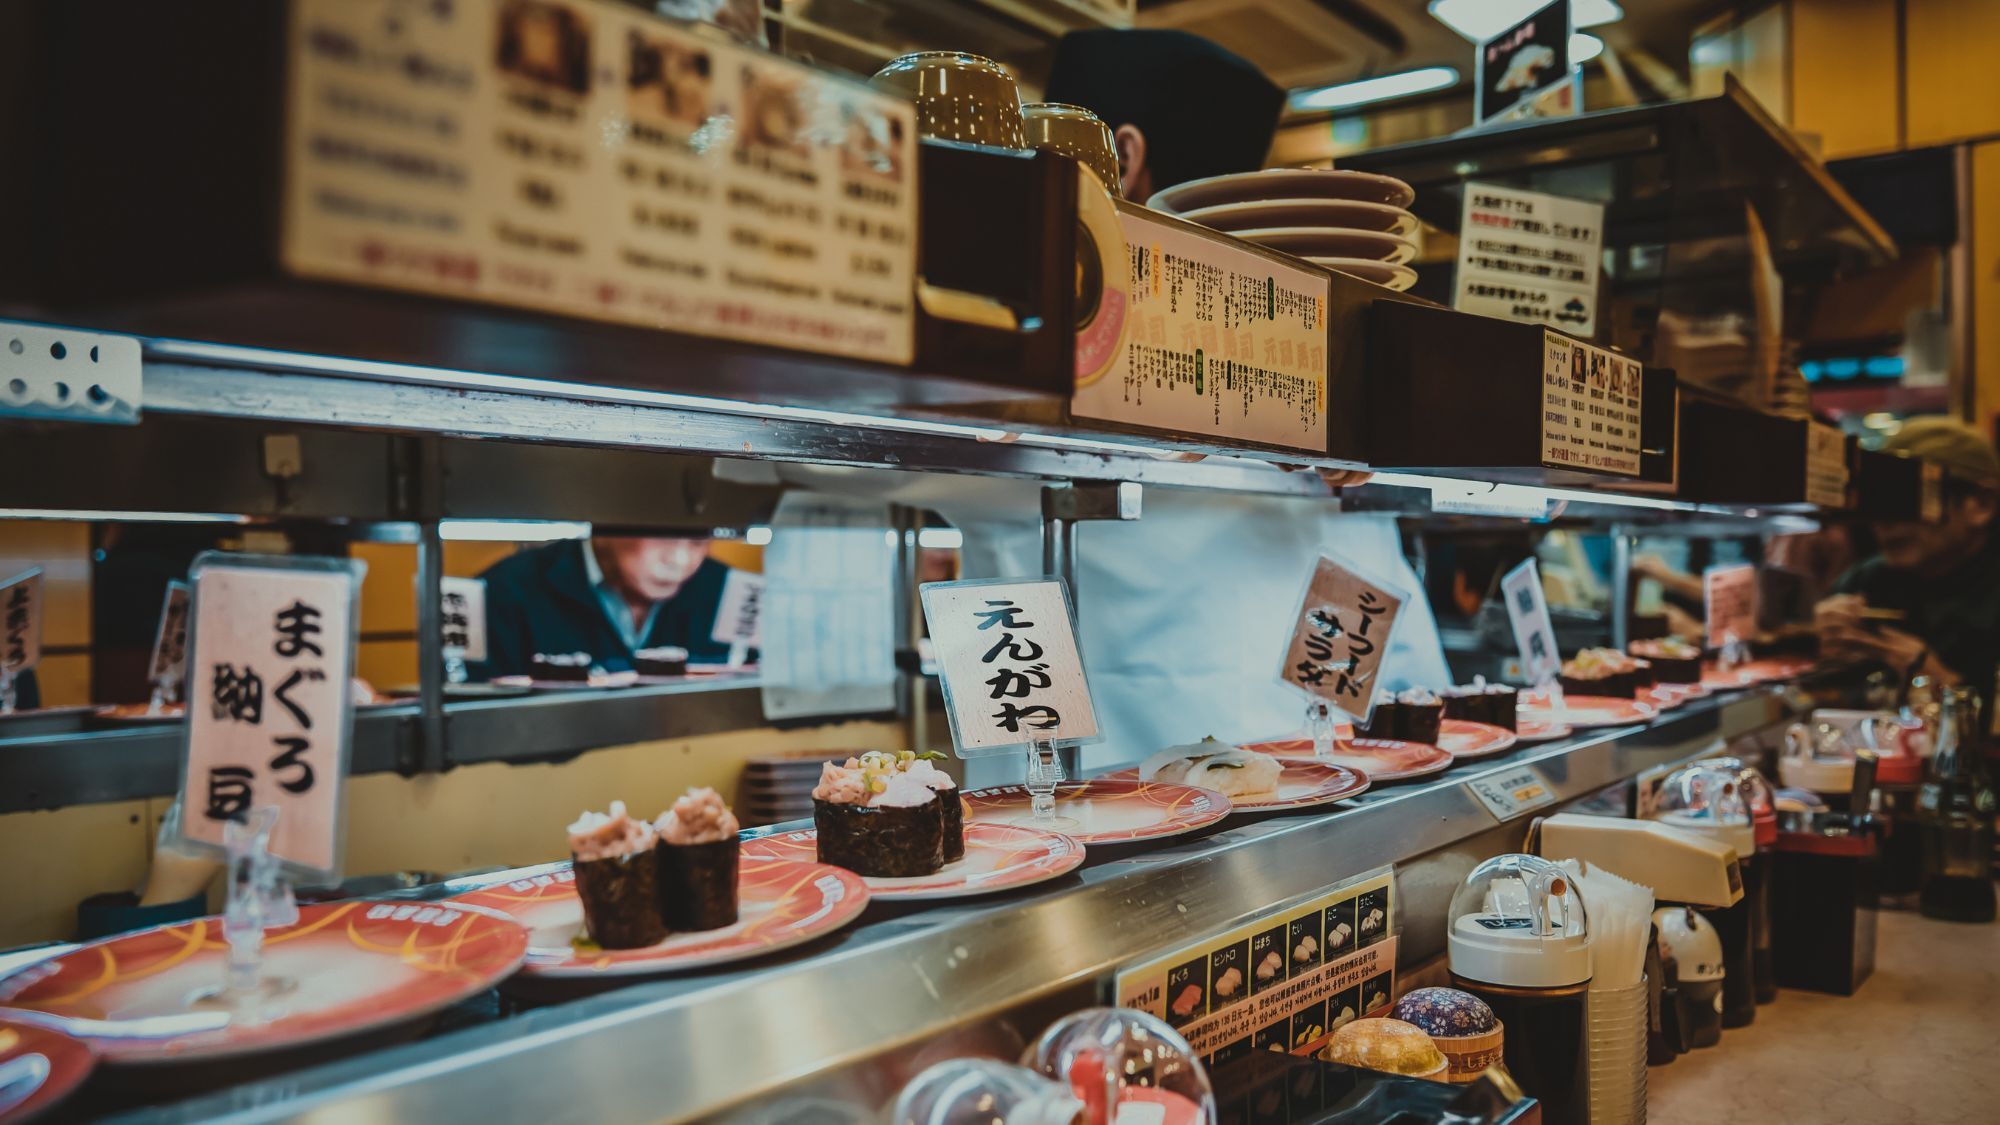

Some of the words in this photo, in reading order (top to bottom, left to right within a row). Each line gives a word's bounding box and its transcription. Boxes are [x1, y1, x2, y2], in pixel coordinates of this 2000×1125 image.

[269, 600, 327, 793] まぐろ
[973, 600, 1061, 732] えんがわ
[1334, 591, 1387, 698] シーフード
[1254, 936, 1271, 951] はまち
[1327, 908, 1337, 921] たこ
